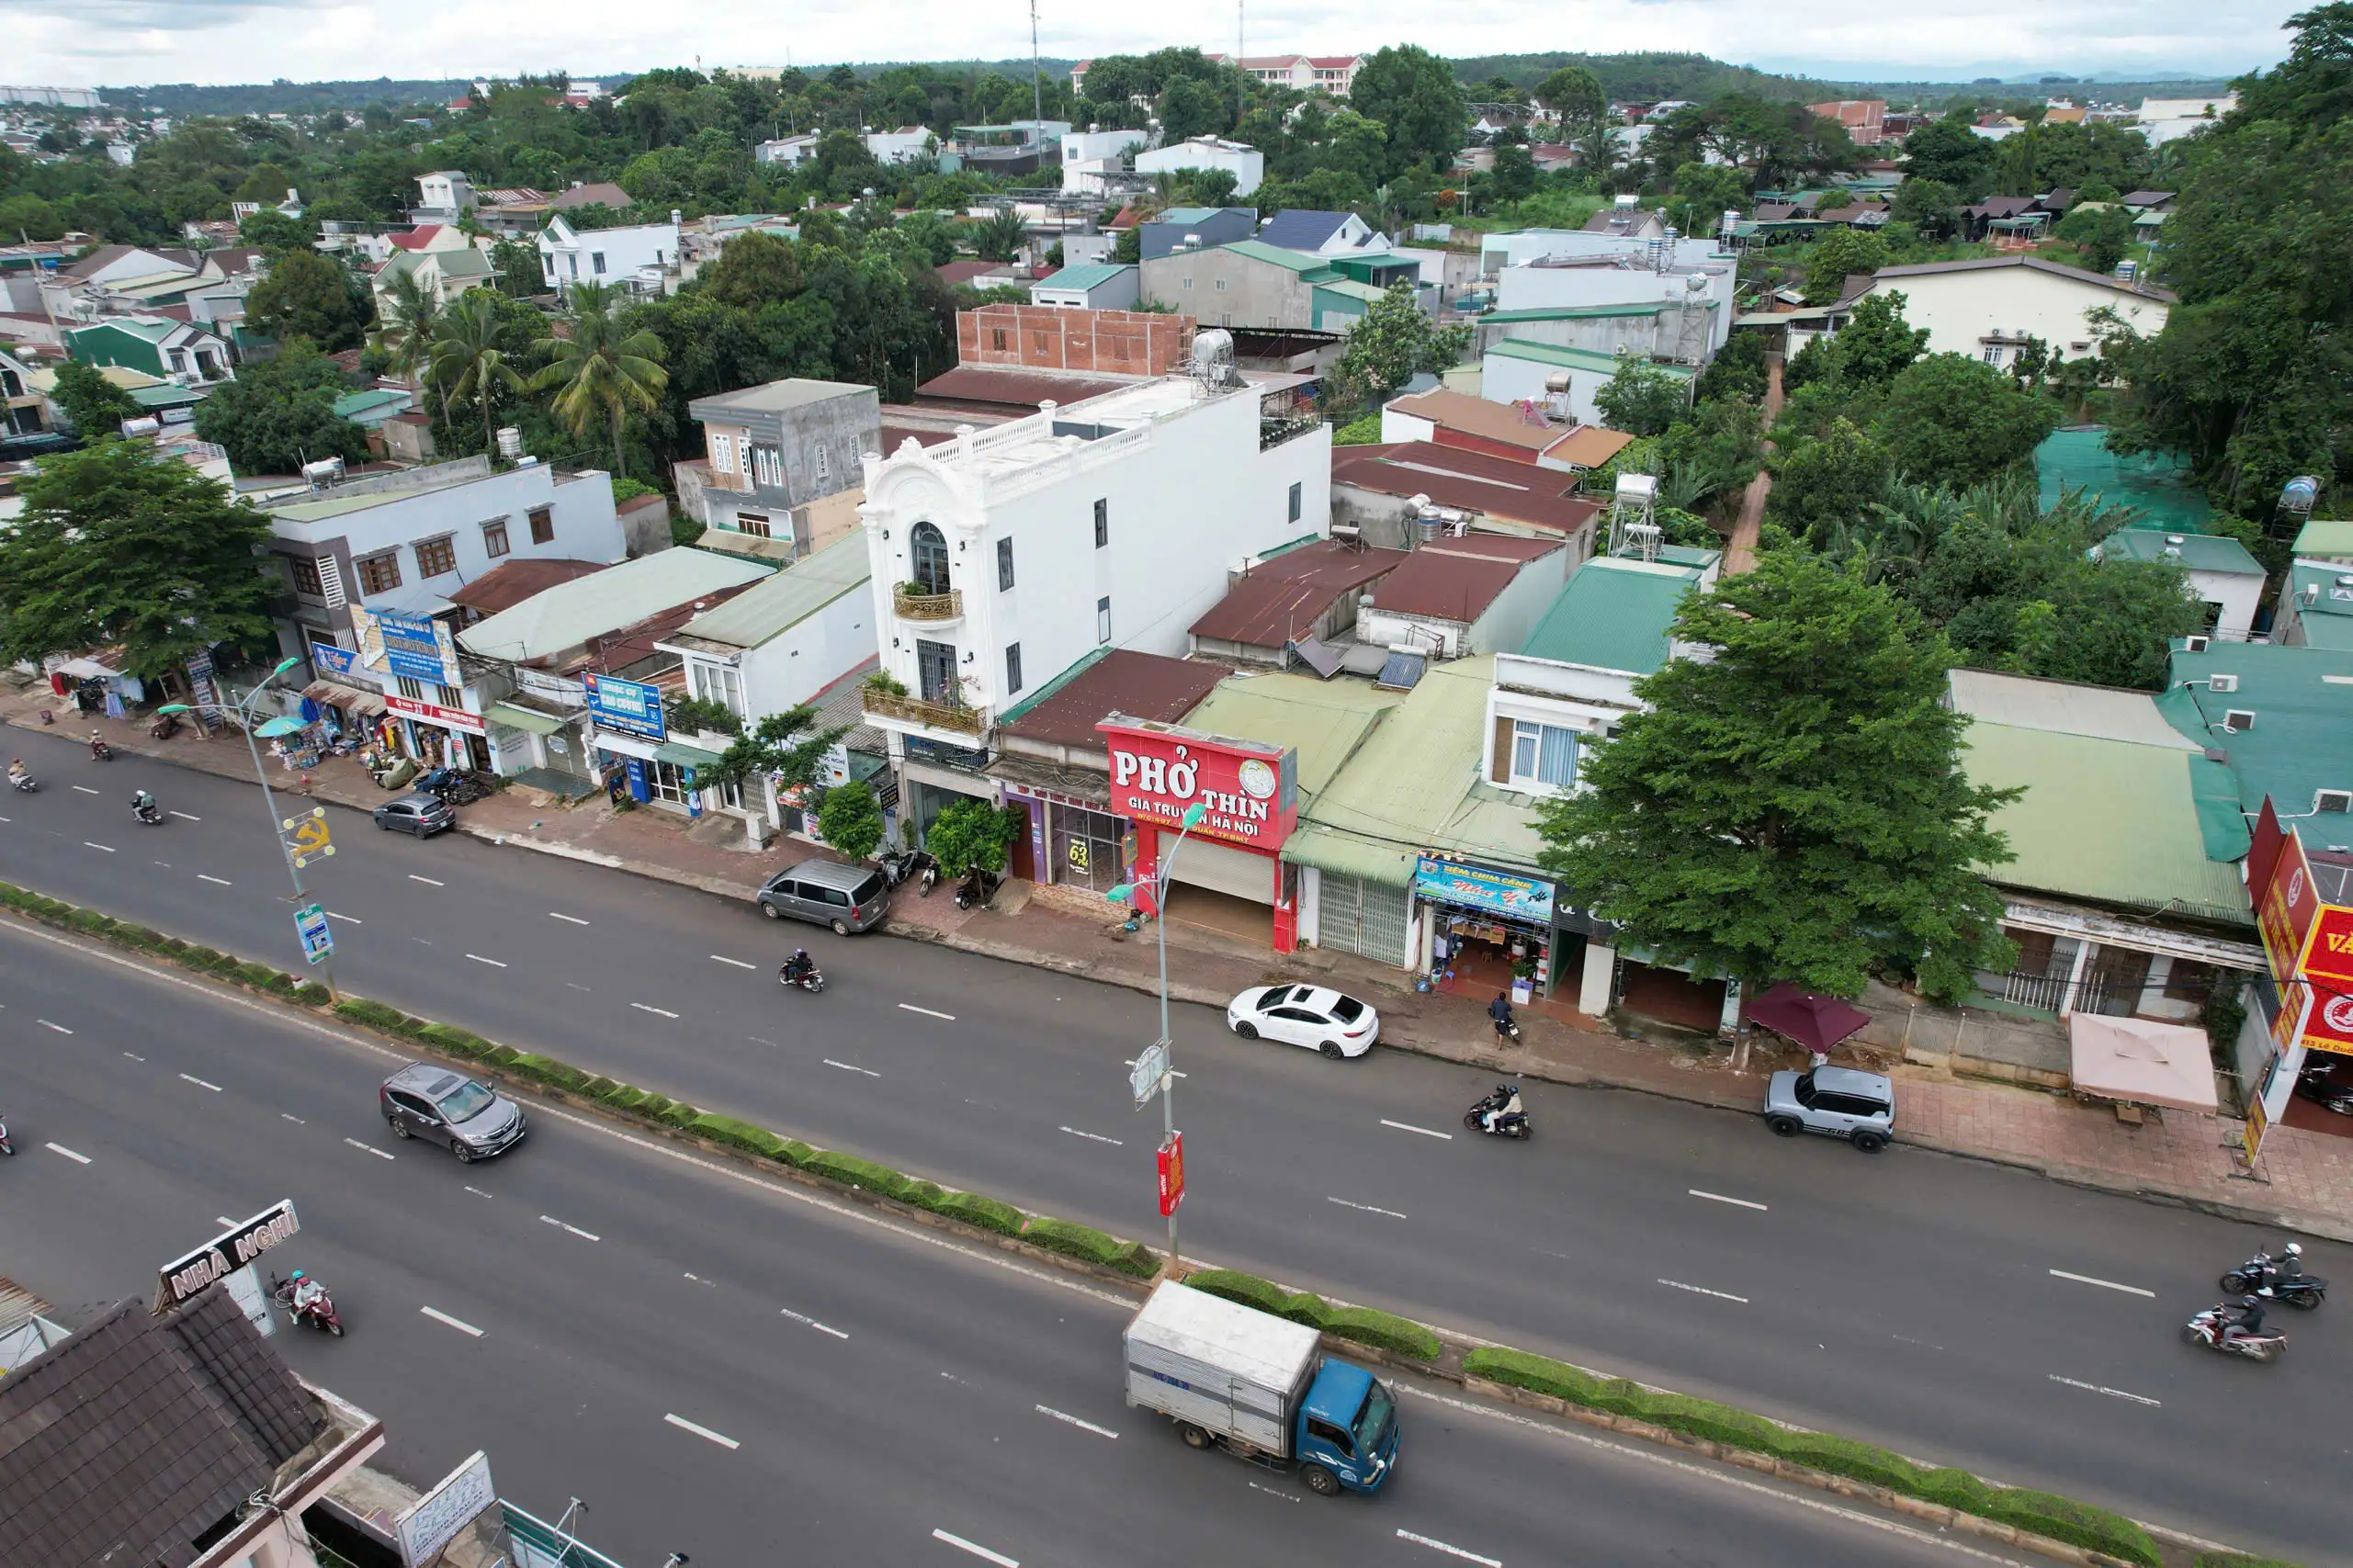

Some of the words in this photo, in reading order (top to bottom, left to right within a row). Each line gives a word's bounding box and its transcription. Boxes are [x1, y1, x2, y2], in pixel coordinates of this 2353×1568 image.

[919, 740, 937, 750] CMC
[1114, 745, 1199, 799] PHỞ
[1128, 796, 1150, 811] GIA
[1153, 801, 1208, 825] TRUYN
[1212, 814, 1231, 831] HÀ
[1234, 819, 1259, 837] NỘI
[1201, 789, 1269, 822] THÌN
[1471, 872, 1500, 883] CHIM
[171, 1247, 232, 1300] NHÀ
[235, 1204, 300, 1263] NGHỈ
